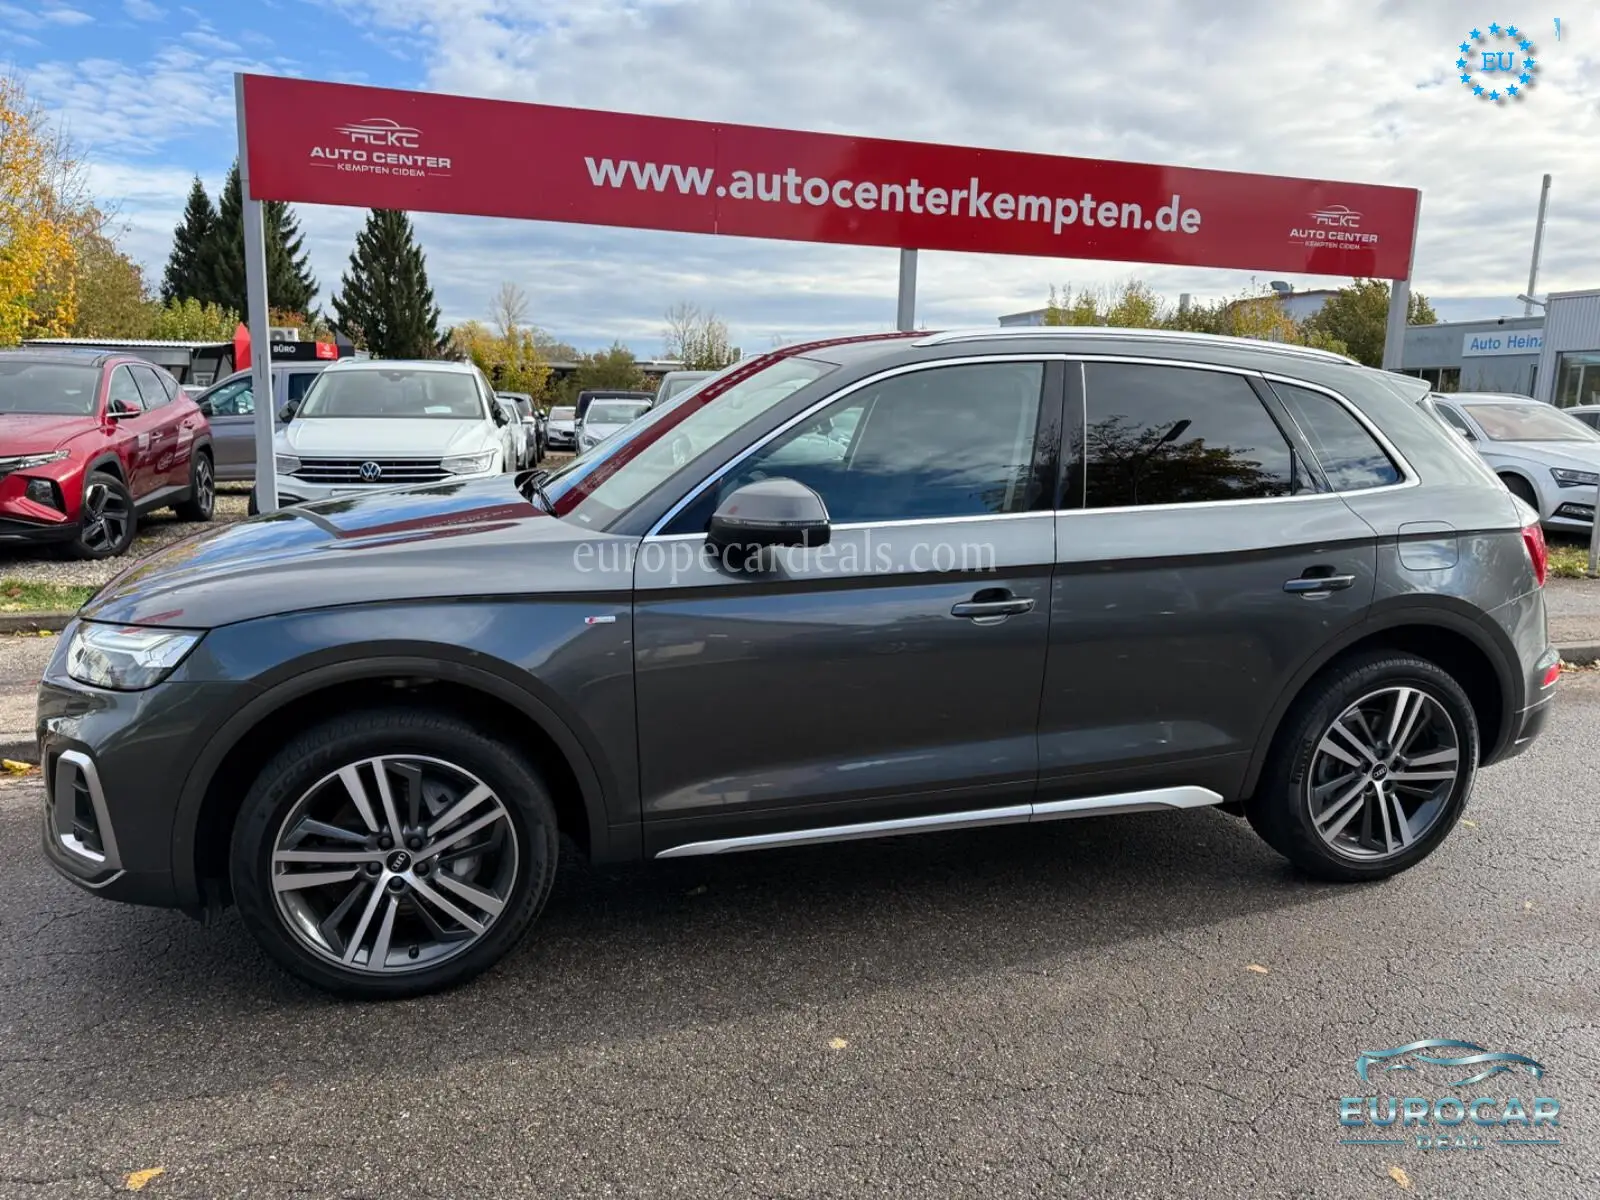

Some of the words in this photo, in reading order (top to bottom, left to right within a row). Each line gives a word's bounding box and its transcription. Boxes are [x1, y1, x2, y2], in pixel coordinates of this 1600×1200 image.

[310, 146, 367, 161] AUTO
[373, 152, 451, 168] CENTER
[337, 163, 390, 175] KEMPTEN
[392, 168, 425, 177] CIDEM
[584, 156, 1202, 235] www.autocenterkempten.de
[1290, 228, 1326, 239] AUTO
[1329, 231, 1377, 242] CENTER
[1305, 241, 1339, 249] KEMPTEN
[273, 343, 296, 353] BÜRO
[1470, 337, 1501, 350] Auto
